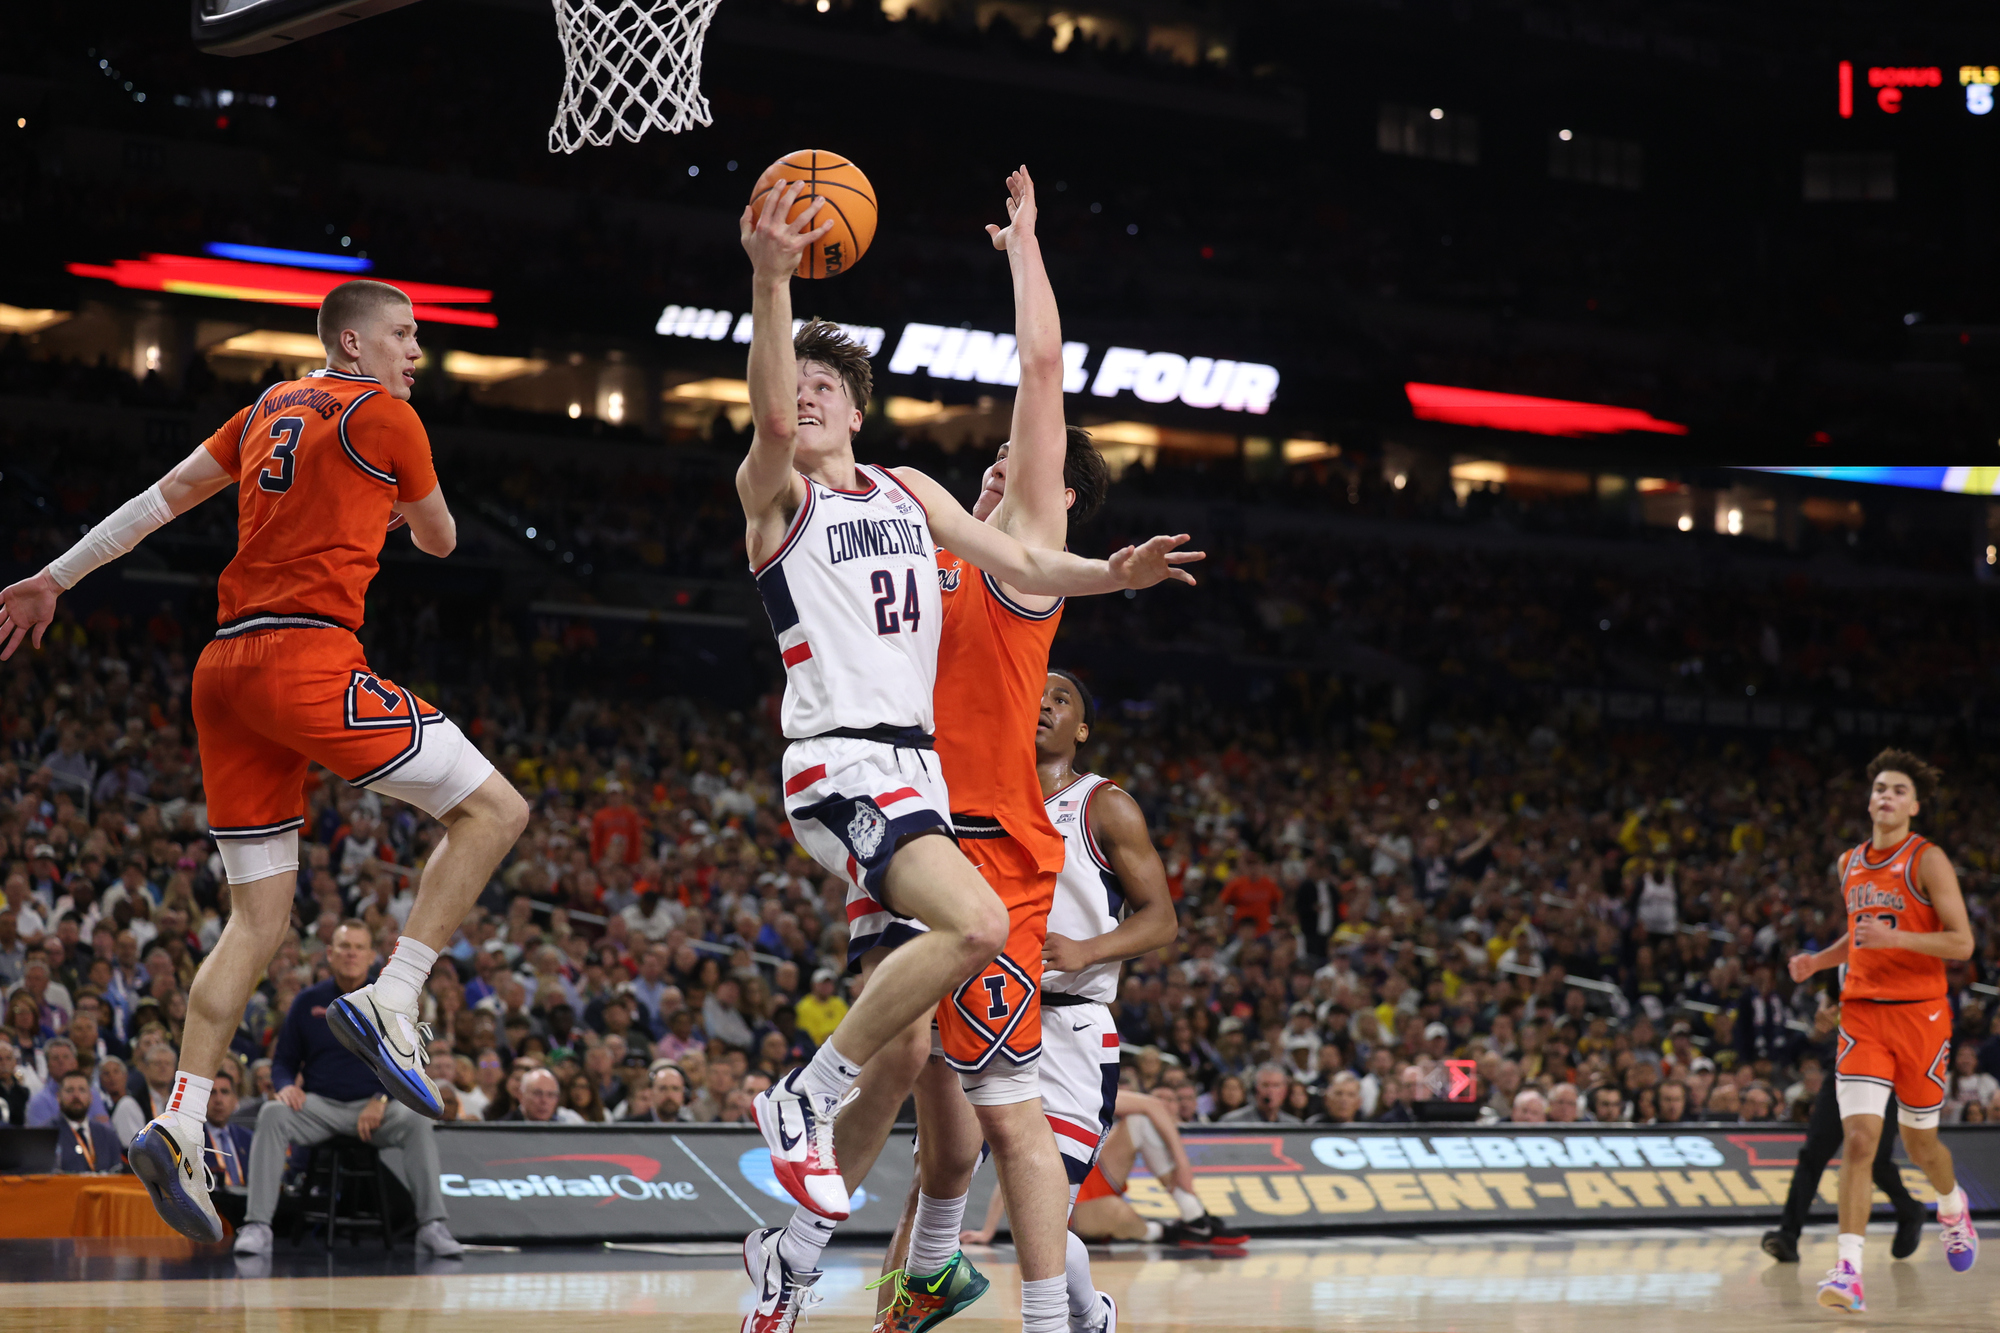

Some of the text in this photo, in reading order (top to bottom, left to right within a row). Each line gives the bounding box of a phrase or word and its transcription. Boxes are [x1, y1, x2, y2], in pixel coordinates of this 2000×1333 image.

[889, 322, 1089, 394] FINL
[1091, 346, 1280, 415] FOUR
[264, 388, 343, 420] HUMRICHOUS
[258, 416, 305, 493] 3
[870, 568, 921, 635] 24
[1847, 881, 1907, 914] Illinois
[982, 973, 1010, 1020] I
[1310, 1136, 1725, 1170] CELEBRATES
